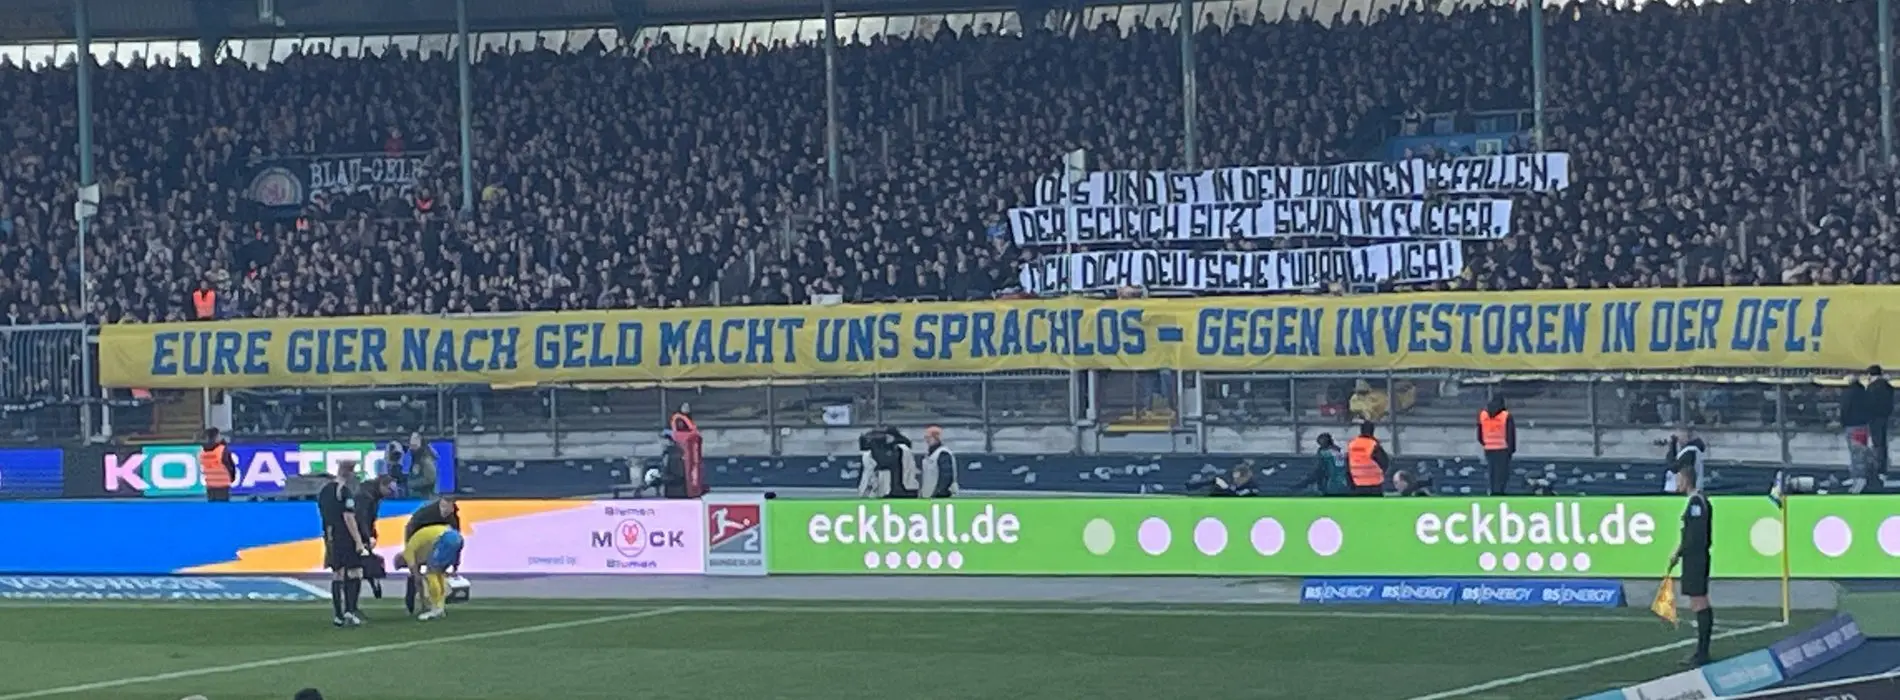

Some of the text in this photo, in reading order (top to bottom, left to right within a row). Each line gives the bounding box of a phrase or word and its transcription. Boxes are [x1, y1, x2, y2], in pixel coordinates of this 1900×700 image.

[1104, 168, 1158, 205] KIND
[1165, 171, 1203, 205] IST
[1213, 168, 1236, 201] IN
[1243, 167, 1291, 200] DEN
[1019, 208, 1066, 241] DER
[1077, 203, 1180, 240] SCHEICH
[1190, 201, 1262, 237] SITZT
[1361, 201, 1384, 236] IM
[1391, 200, 1501, 236] FLIEGER.
[1082, 252, 1132, 288] DICH
[1143, 250, 1268, 288] DEUTSCHE
[151, 331, 272, 375] EURE
[287, 328, 388, 373] GIER
[402, 327, 521, 372] NACH
[534, 322, 643, 368] GELD
[659, 318, 804, 366] MACHT
[815, 313, 902, 362] UNS
[913, 308, 1146, 359] SPRACHLOS
[1196, 307, 1324, 356] GEGEN
[1335, 301, 1591, 356] INVESTOREN
[1601, 300, 1641, 352] IN
[1649, 298, 1724, 352] DER
[1730, 297, 1830, 352] DFL!
[744, 529, 759, 551] 2
[808, 503, 1020, 544] eckball.de
[1415, 501, 1656, 545] eckball.de
